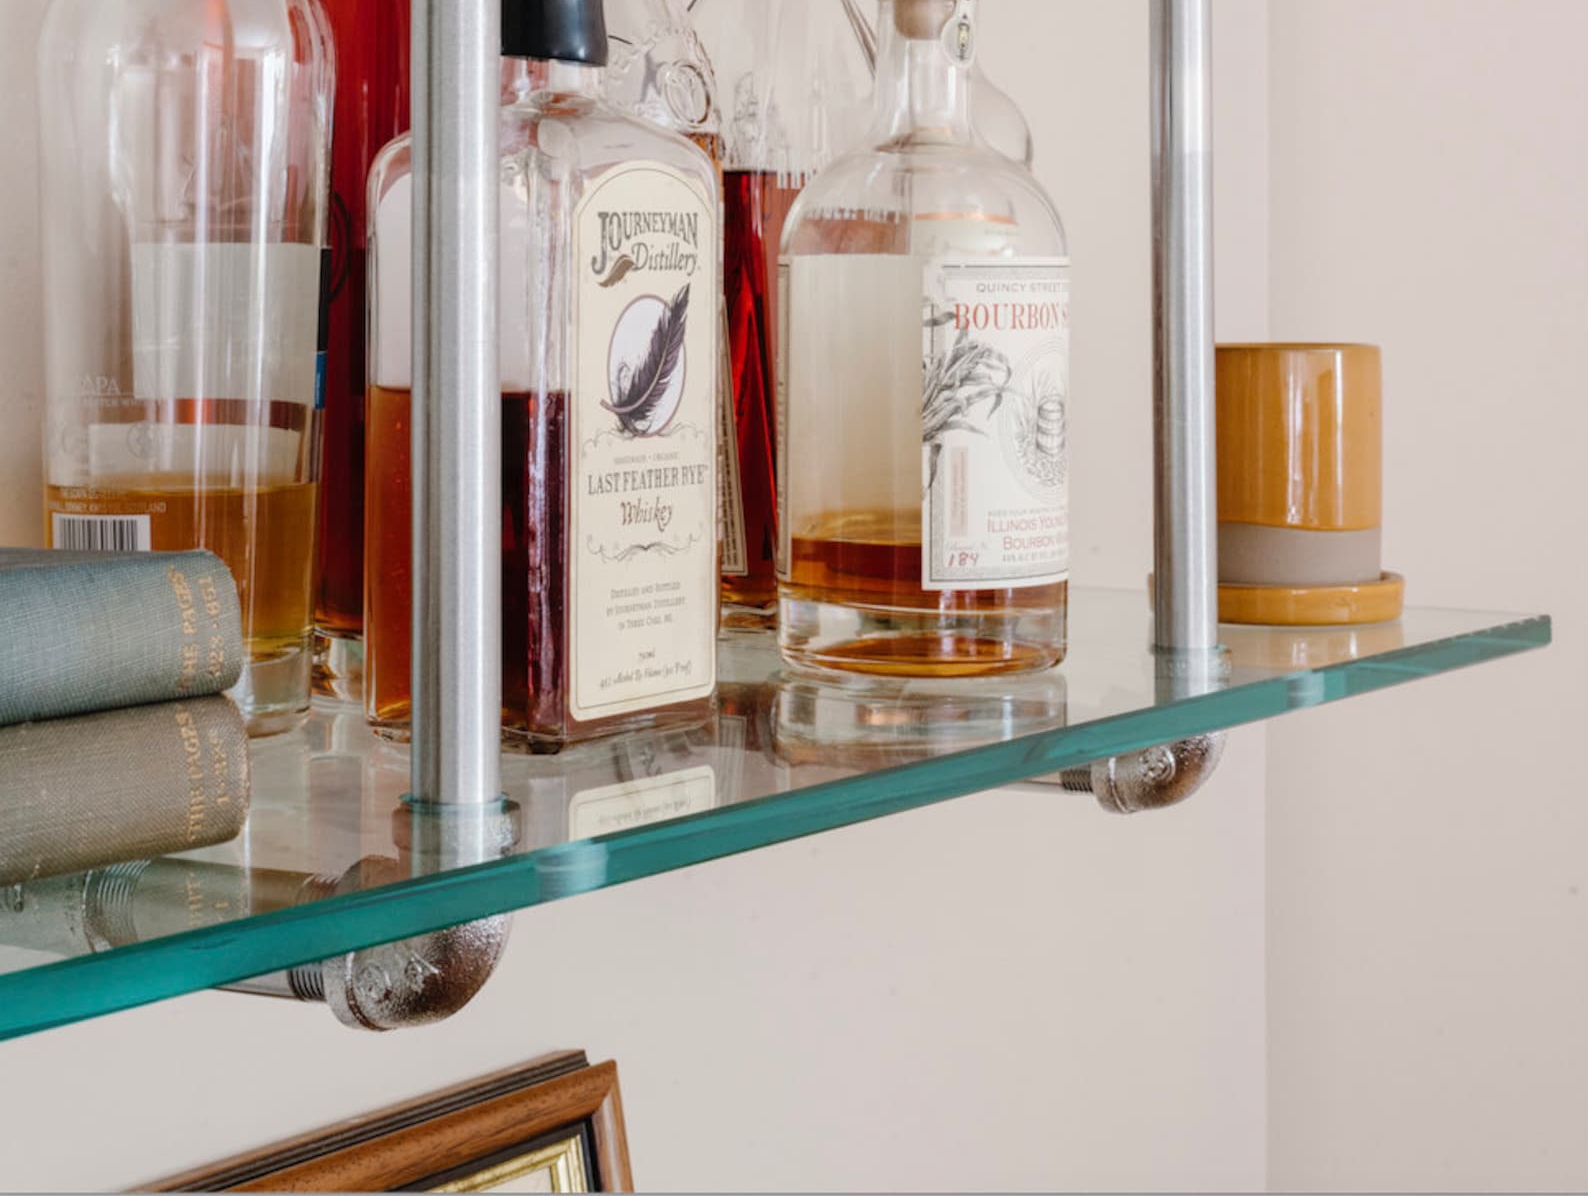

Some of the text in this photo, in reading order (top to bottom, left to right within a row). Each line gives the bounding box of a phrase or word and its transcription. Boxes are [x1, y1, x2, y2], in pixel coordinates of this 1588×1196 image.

[591, 211, 699, 276] JOURNEYMAN
[975, 282, 1026, 294] QUINCY
[588, 471, 621, 496] LAST
[622, 466, 679, 492] FEATHER
